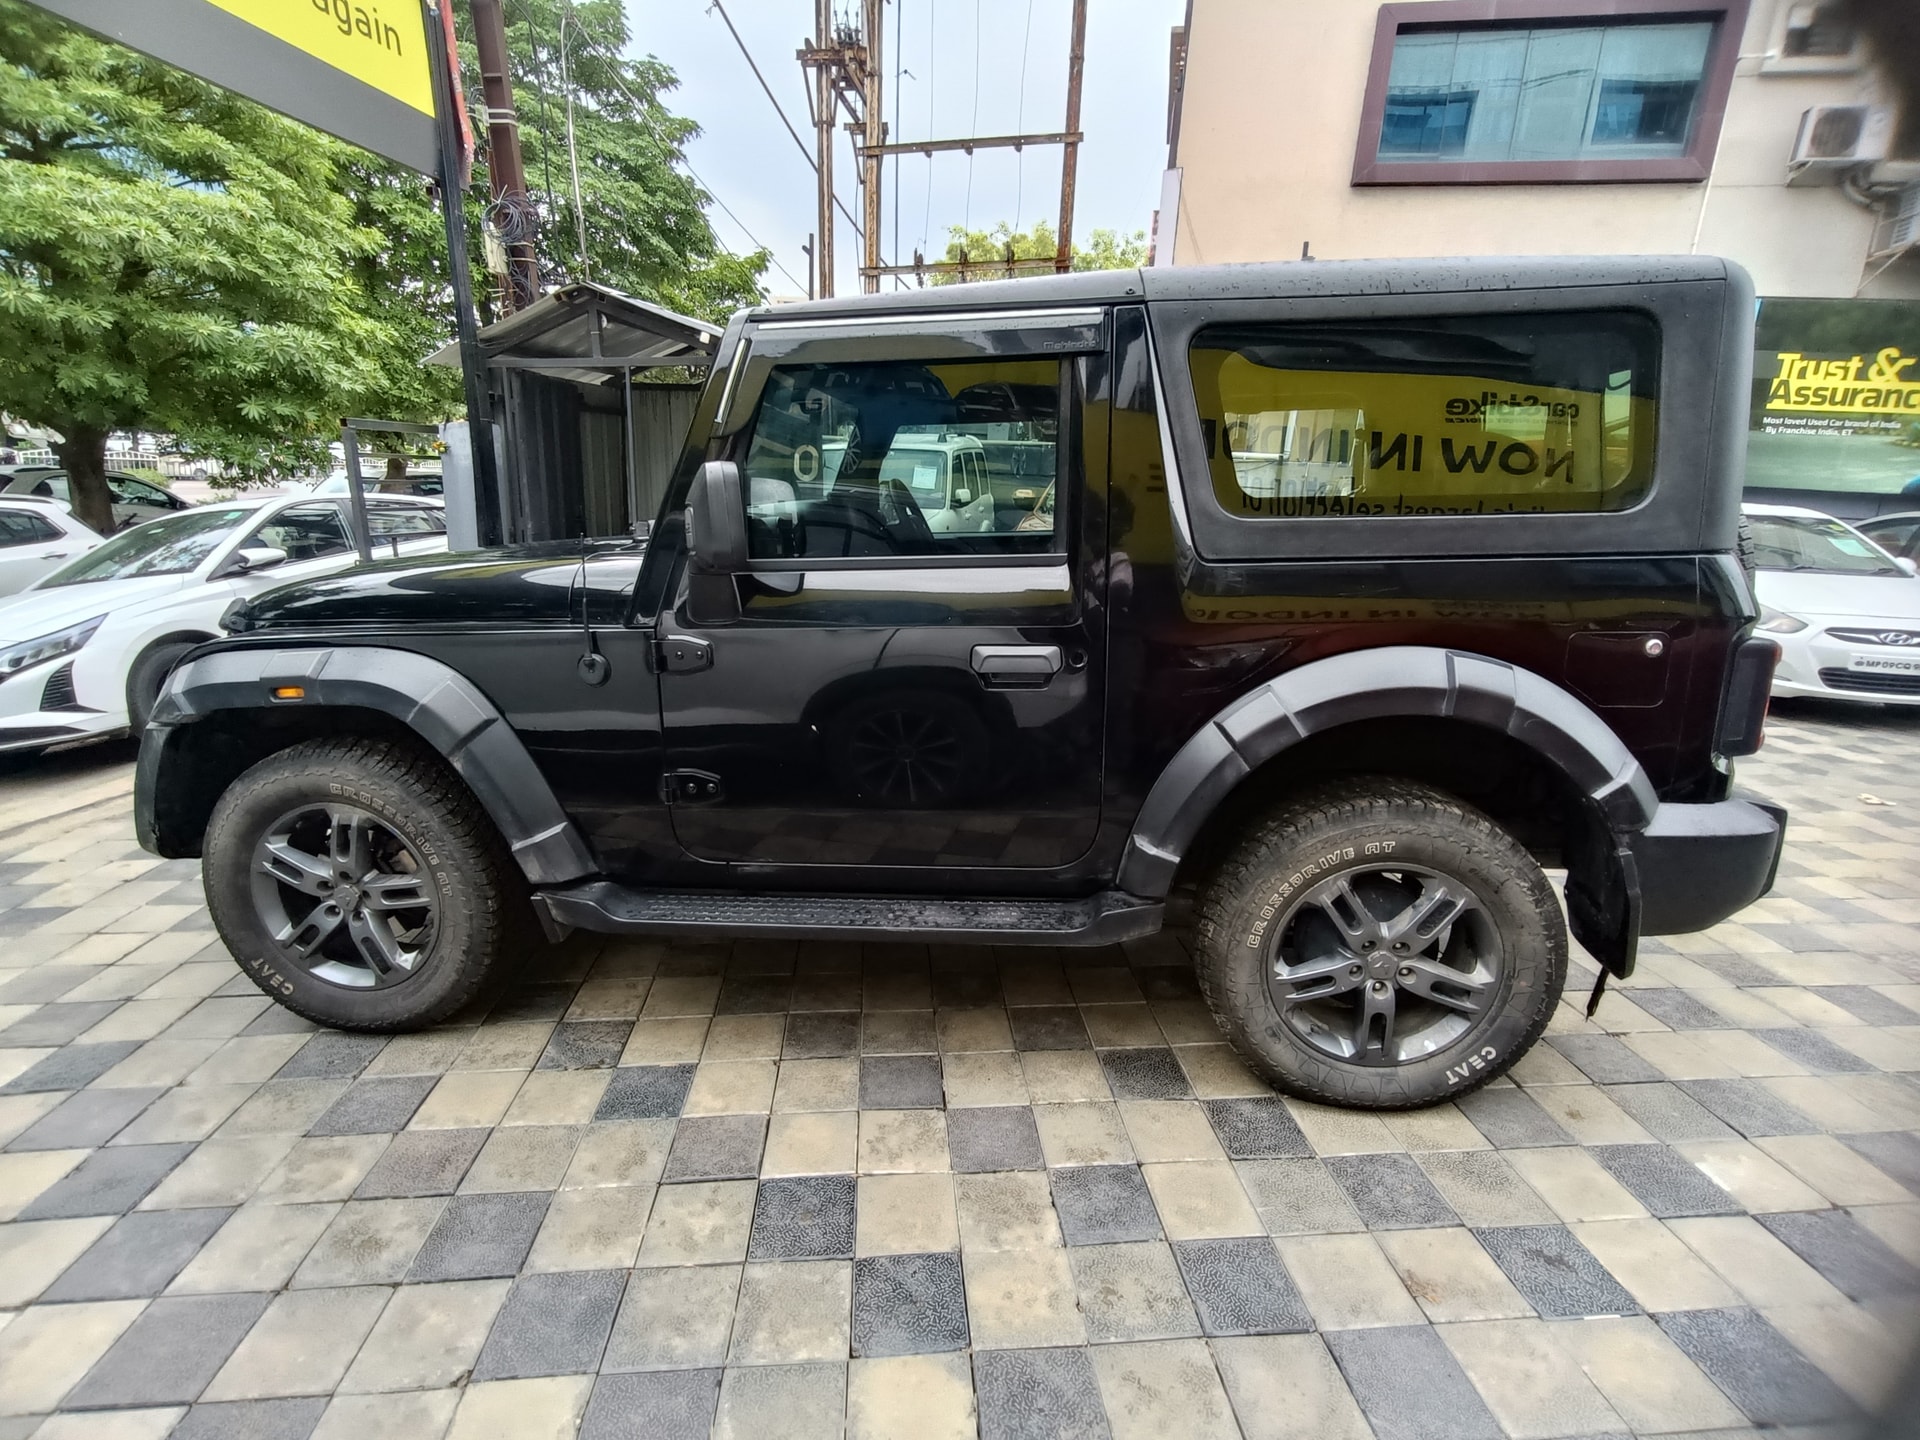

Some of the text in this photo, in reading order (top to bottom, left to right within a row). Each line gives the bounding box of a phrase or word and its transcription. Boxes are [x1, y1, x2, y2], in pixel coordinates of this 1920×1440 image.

[1777, 346, 1918, 383] Trust &
[1763, 416, 1901, 429] Most loved Used Car brand of India
[1766, 426, 1777, 435] By
[1778, 427, 1817, 435] Franchise
[1246, 840, 1396, 949] CROSSDRIVE AT
[250, 957, 294, 996] CEAT
[1446, 1045, 1498, 1086] CEAT
